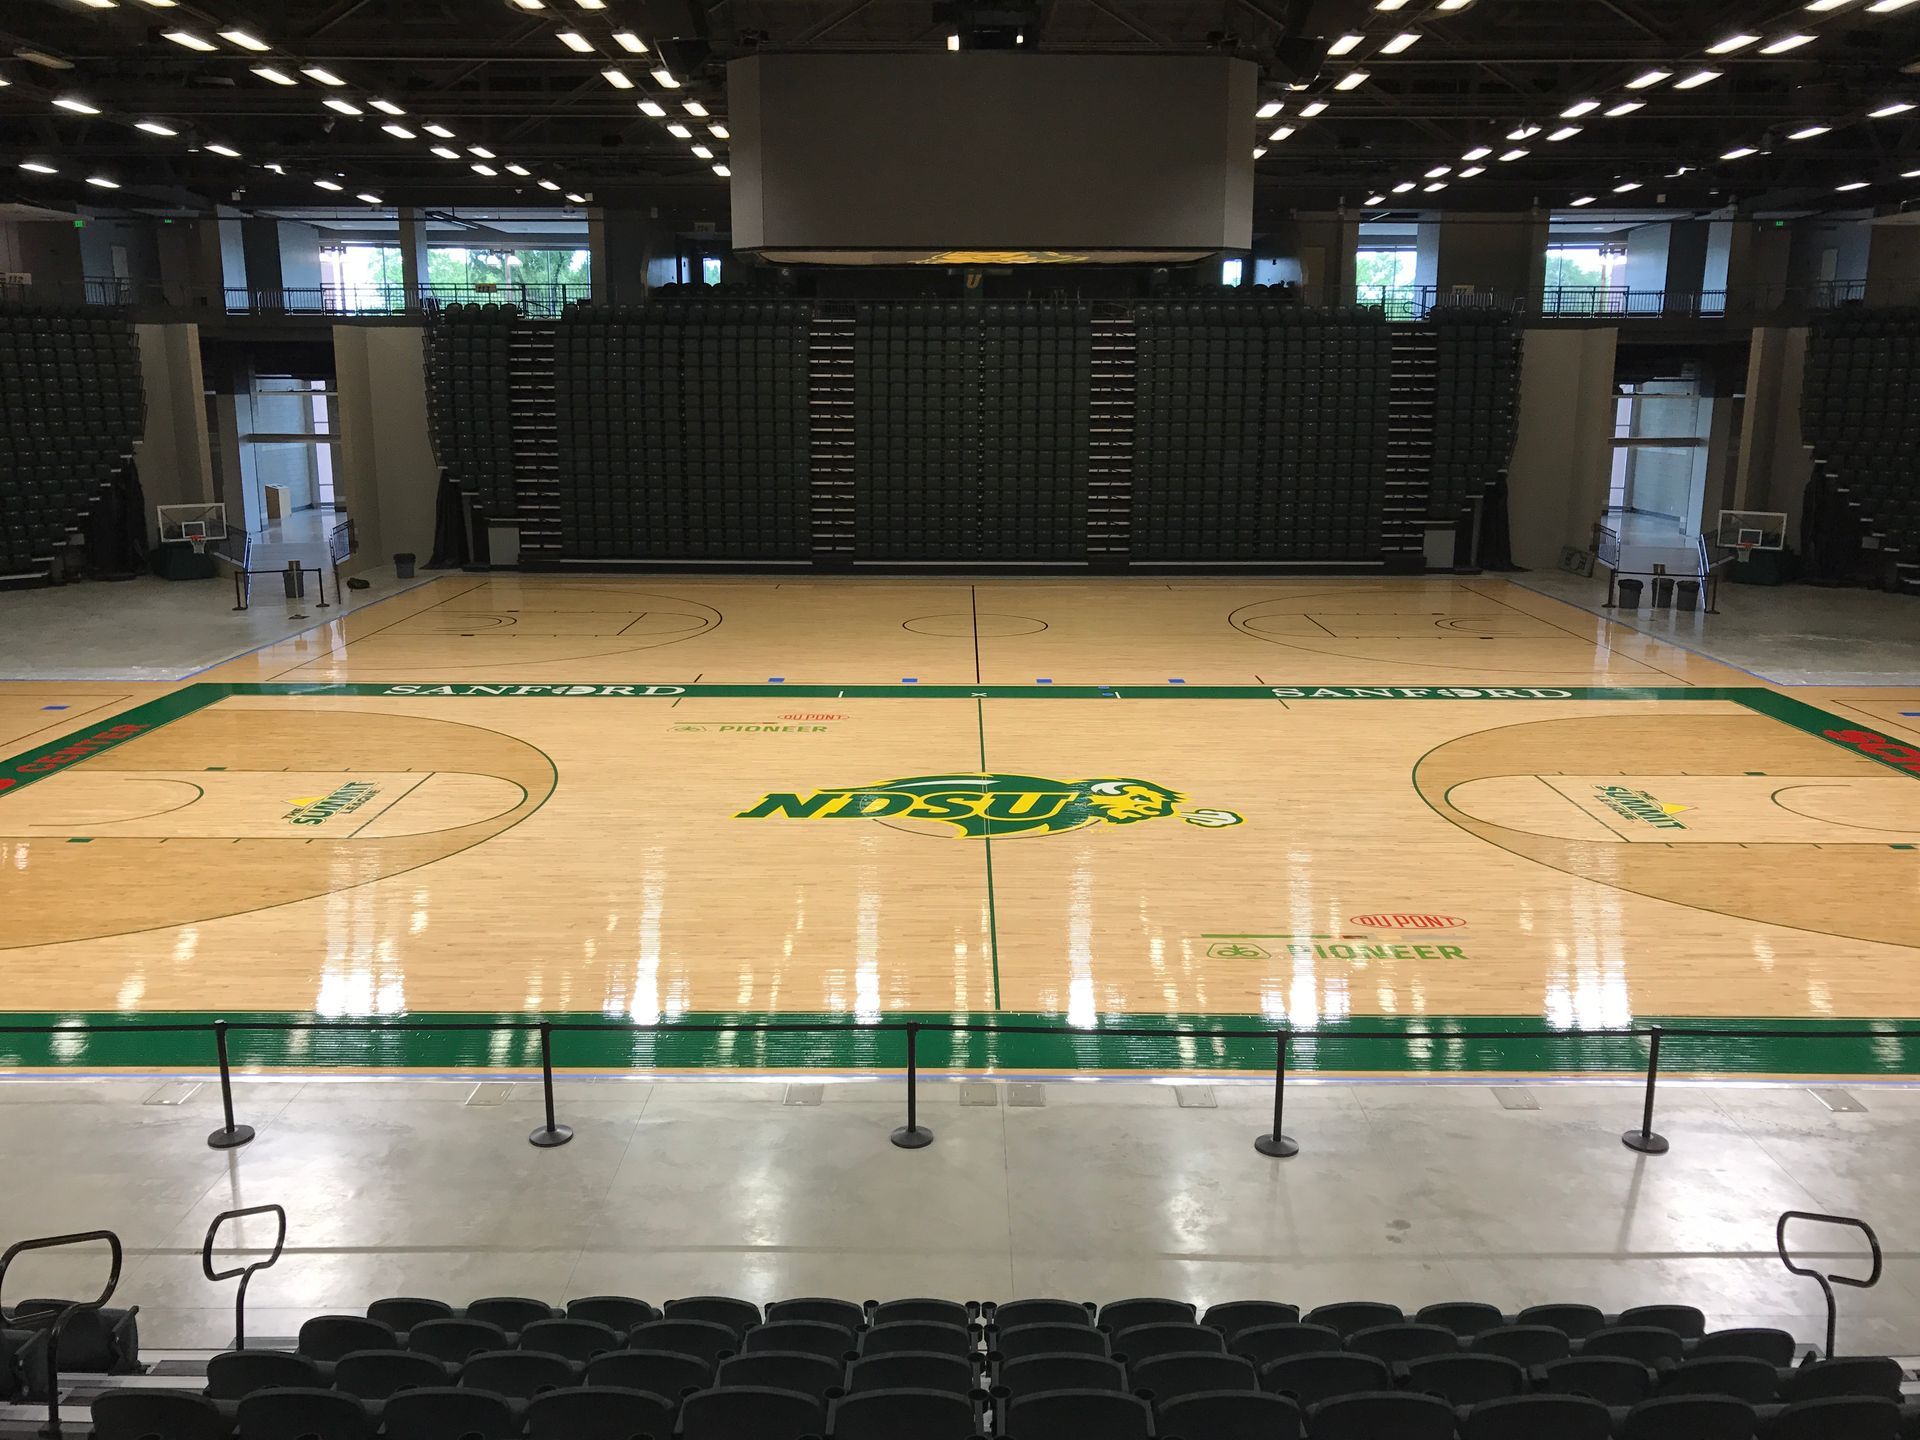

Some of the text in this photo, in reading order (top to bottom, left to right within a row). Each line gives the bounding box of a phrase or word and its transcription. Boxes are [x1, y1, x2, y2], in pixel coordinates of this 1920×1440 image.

[384, 685, 686, 696] SANFORD
[1271, 688, 1572, 698] SANFORD
[719, 725, 828, 733] PIONEER
[16, 724, 150, 773] CENTER
[292, 781, 376, 825] SUMMIT
[734, 791, 1082, 819] NDSU
[1594, 785, 1688, 830] SUMMIT
